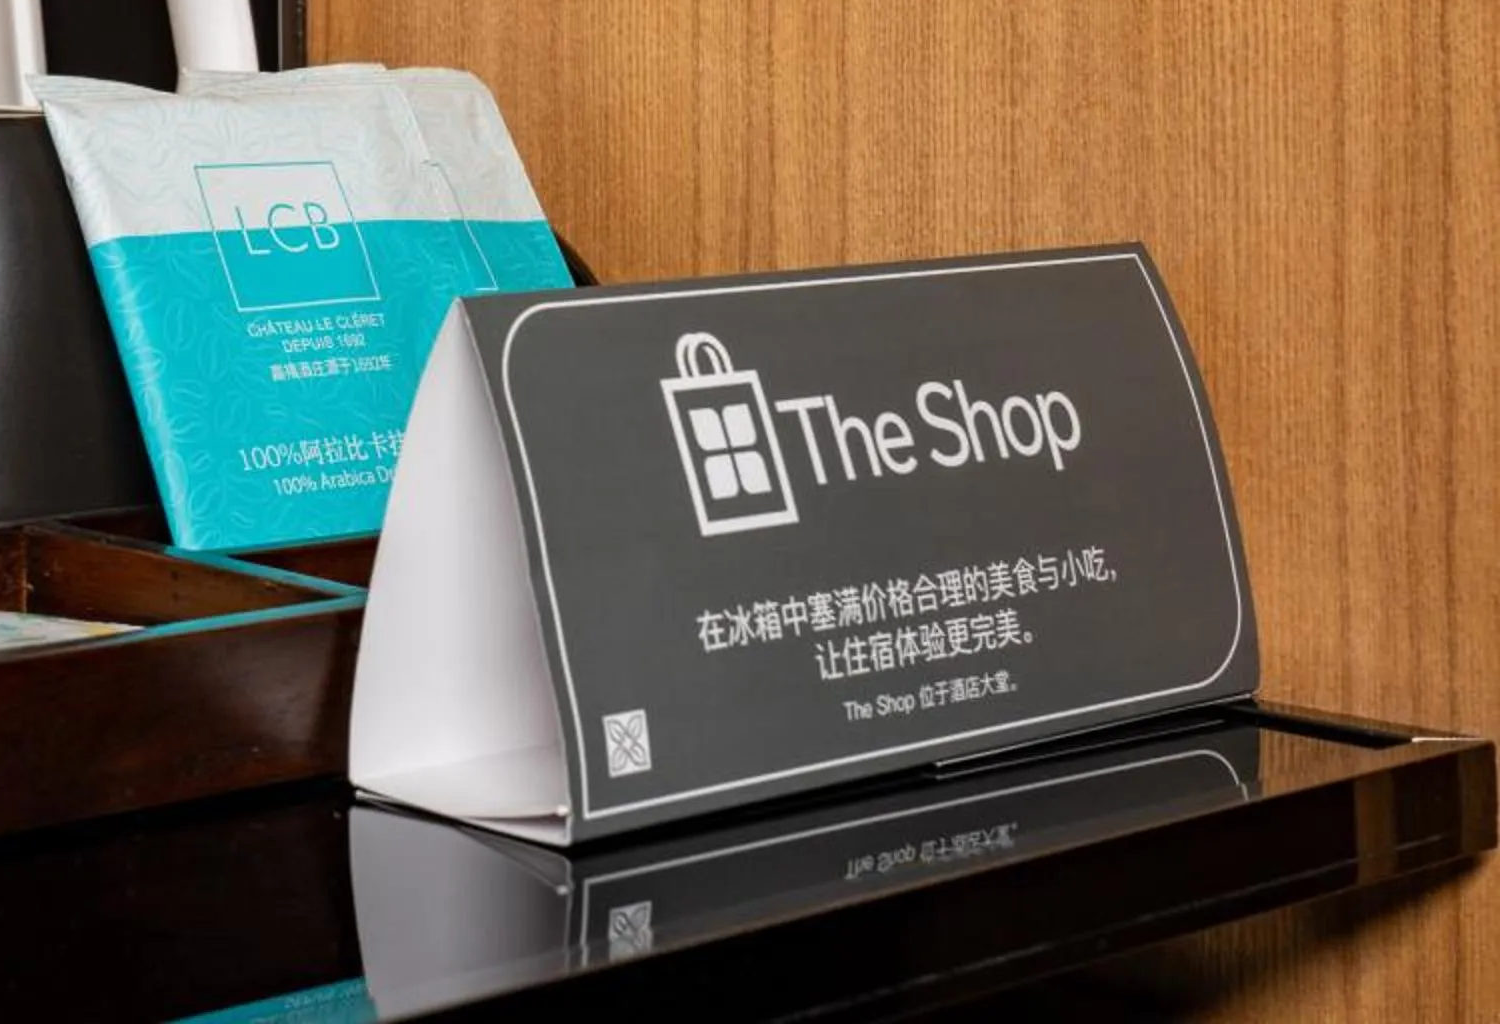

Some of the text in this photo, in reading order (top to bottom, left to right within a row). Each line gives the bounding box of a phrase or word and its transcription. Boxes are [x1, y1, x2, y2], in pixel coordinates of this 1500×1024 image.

[235, 202, 340, 255] LCB
[315, 316, 334, 331] LE
[774, 379, 1082, 485] The Shop
[274, 476, 318, 496] 100%
[320, 469, 376, 491] Arabica
[814, 607, 1034, 681] 让住宿体验更完美。
[843, 700, 874, 721] The
[875, 694, 916, 715] Shop
